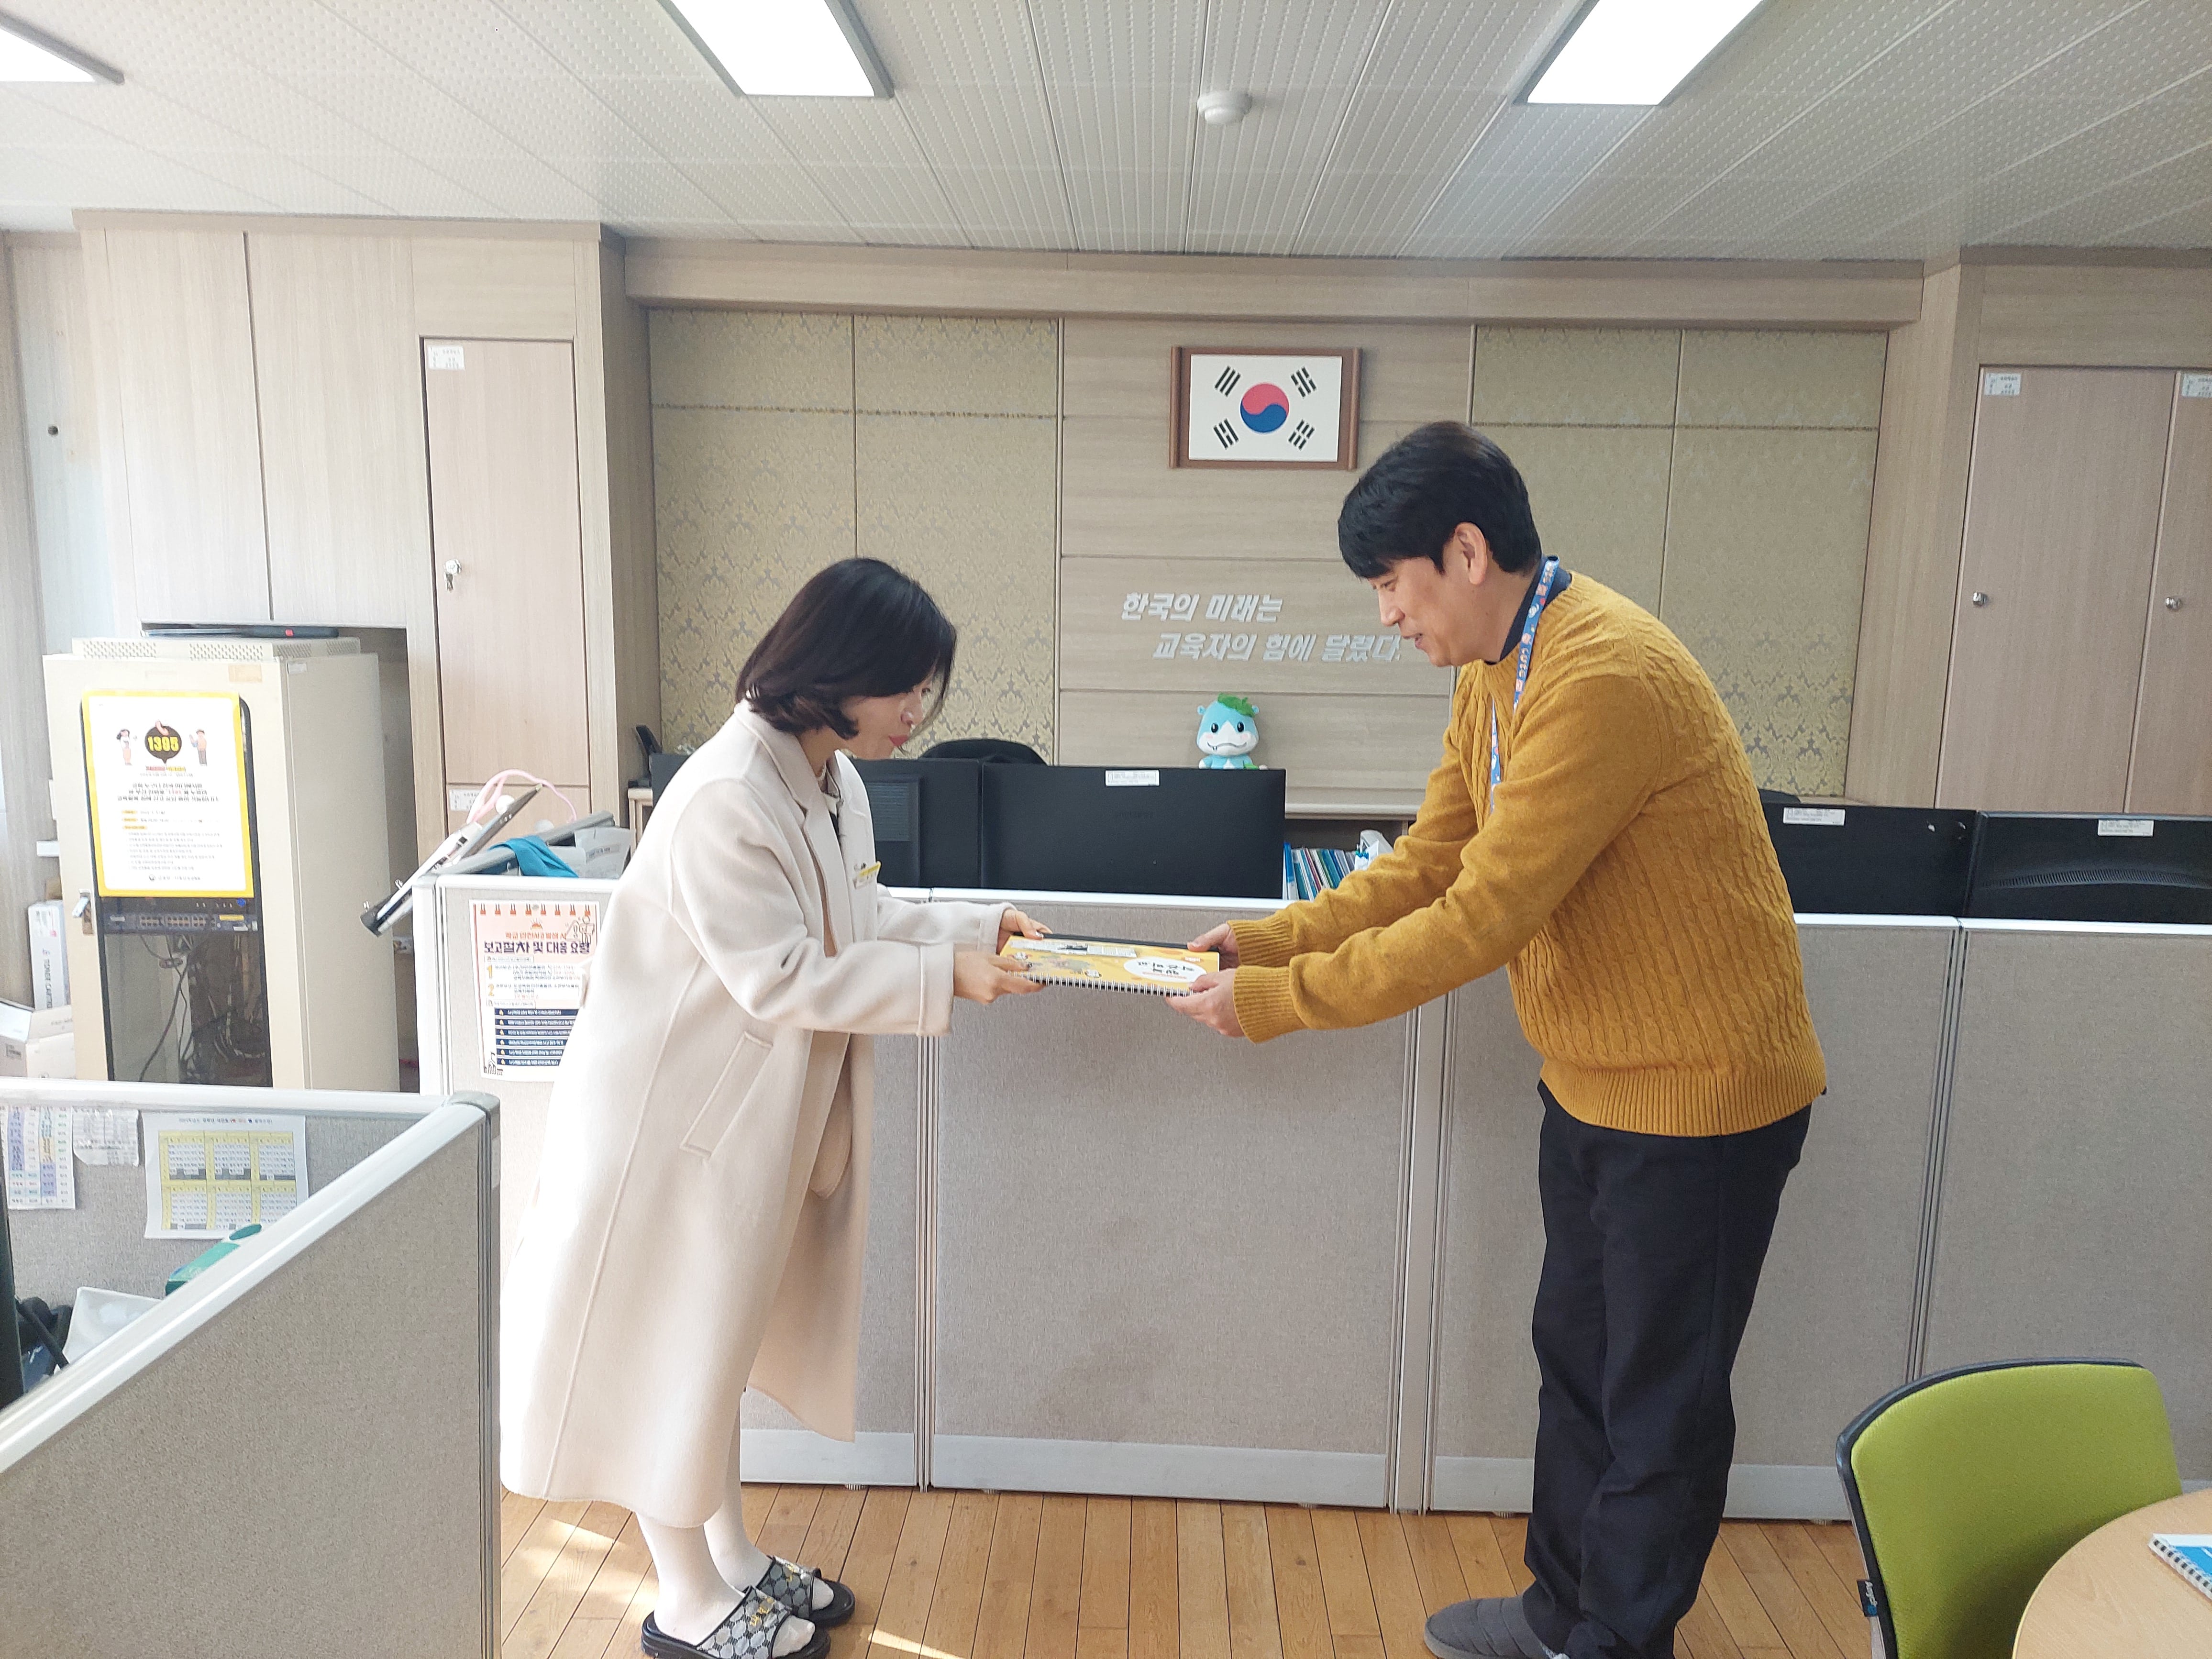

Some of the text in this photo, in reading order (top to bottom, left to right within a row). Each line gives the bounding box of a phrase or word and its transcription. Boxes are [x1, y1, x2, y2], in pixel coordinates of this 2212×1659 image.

[1121, 592, 1283, 622] 한국의 미래는
[1152, 632, 1258, 661] 교육자의
[1262, 632, 1317, 662] 힘에
[484, 941, 590, 953] 보고절차 및 대응 요령
[488, 983, 495, 996] 2
